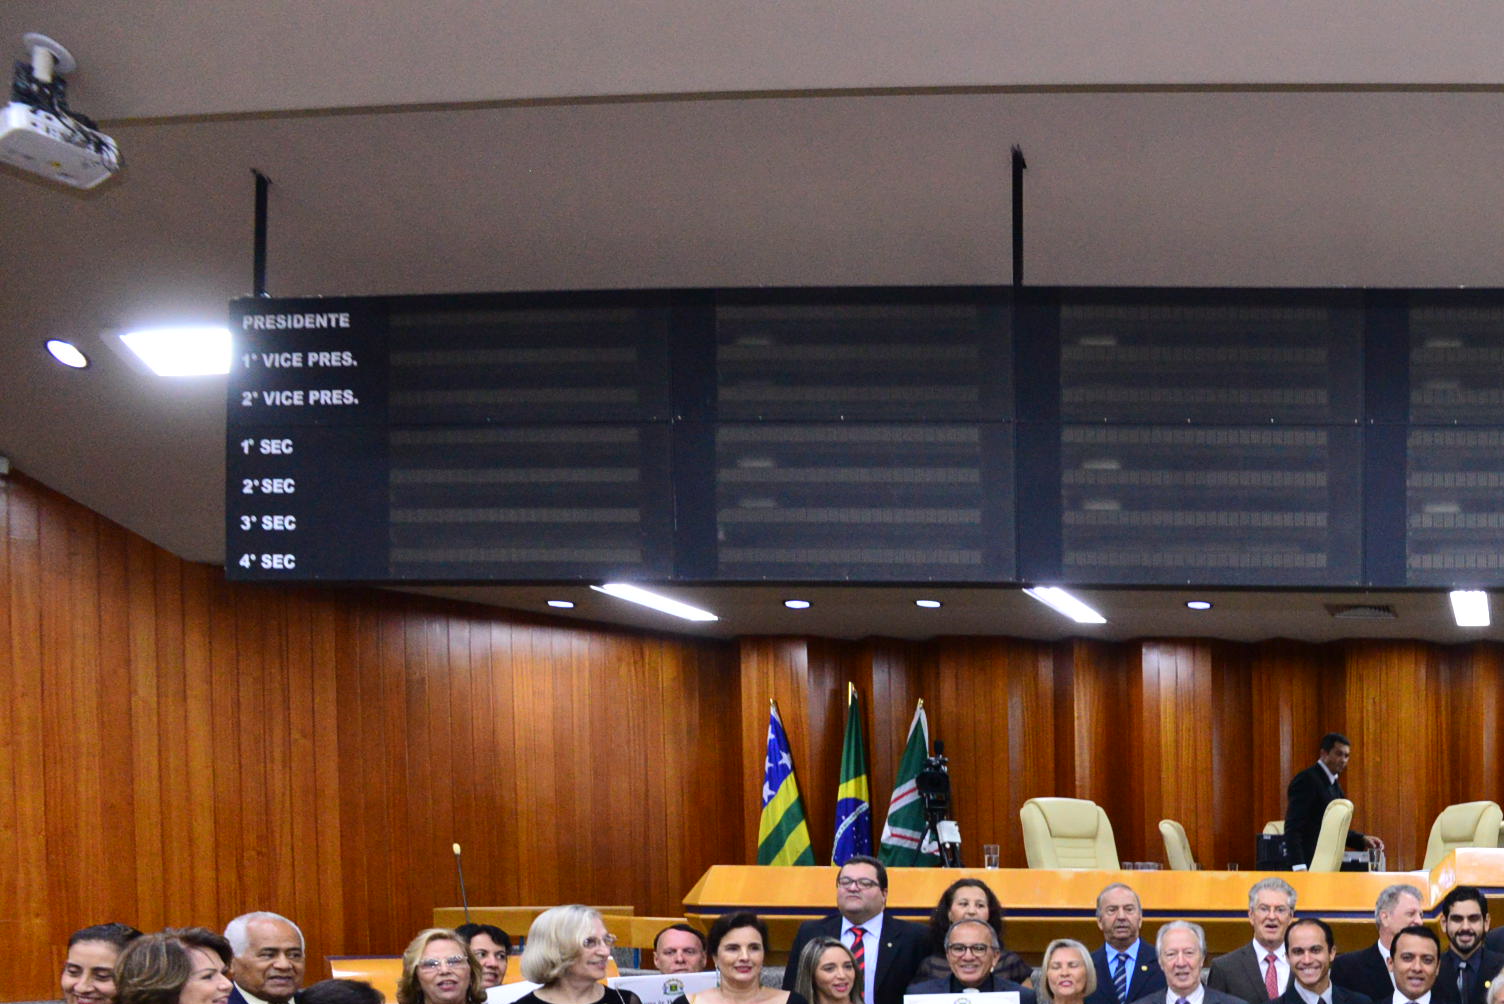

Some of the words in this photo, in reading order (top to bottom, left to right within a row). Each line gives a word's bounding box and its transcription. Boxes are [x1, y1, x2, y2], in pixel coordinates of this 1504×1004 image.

[243, 313, 350, 329] PRESIDENTE
[262, 352, 303, 368] VICE
[307, 351, 358, 367] PRES.
[263, 390, 304, 406] VICE
[308, 389, 359, 405] PRES.
[259, 438, 294, 454] SEC
[260, 478, 295, 494] SEC
[261, 515, 296, 531] SEC
[260, 553, 296, 569] SEC
